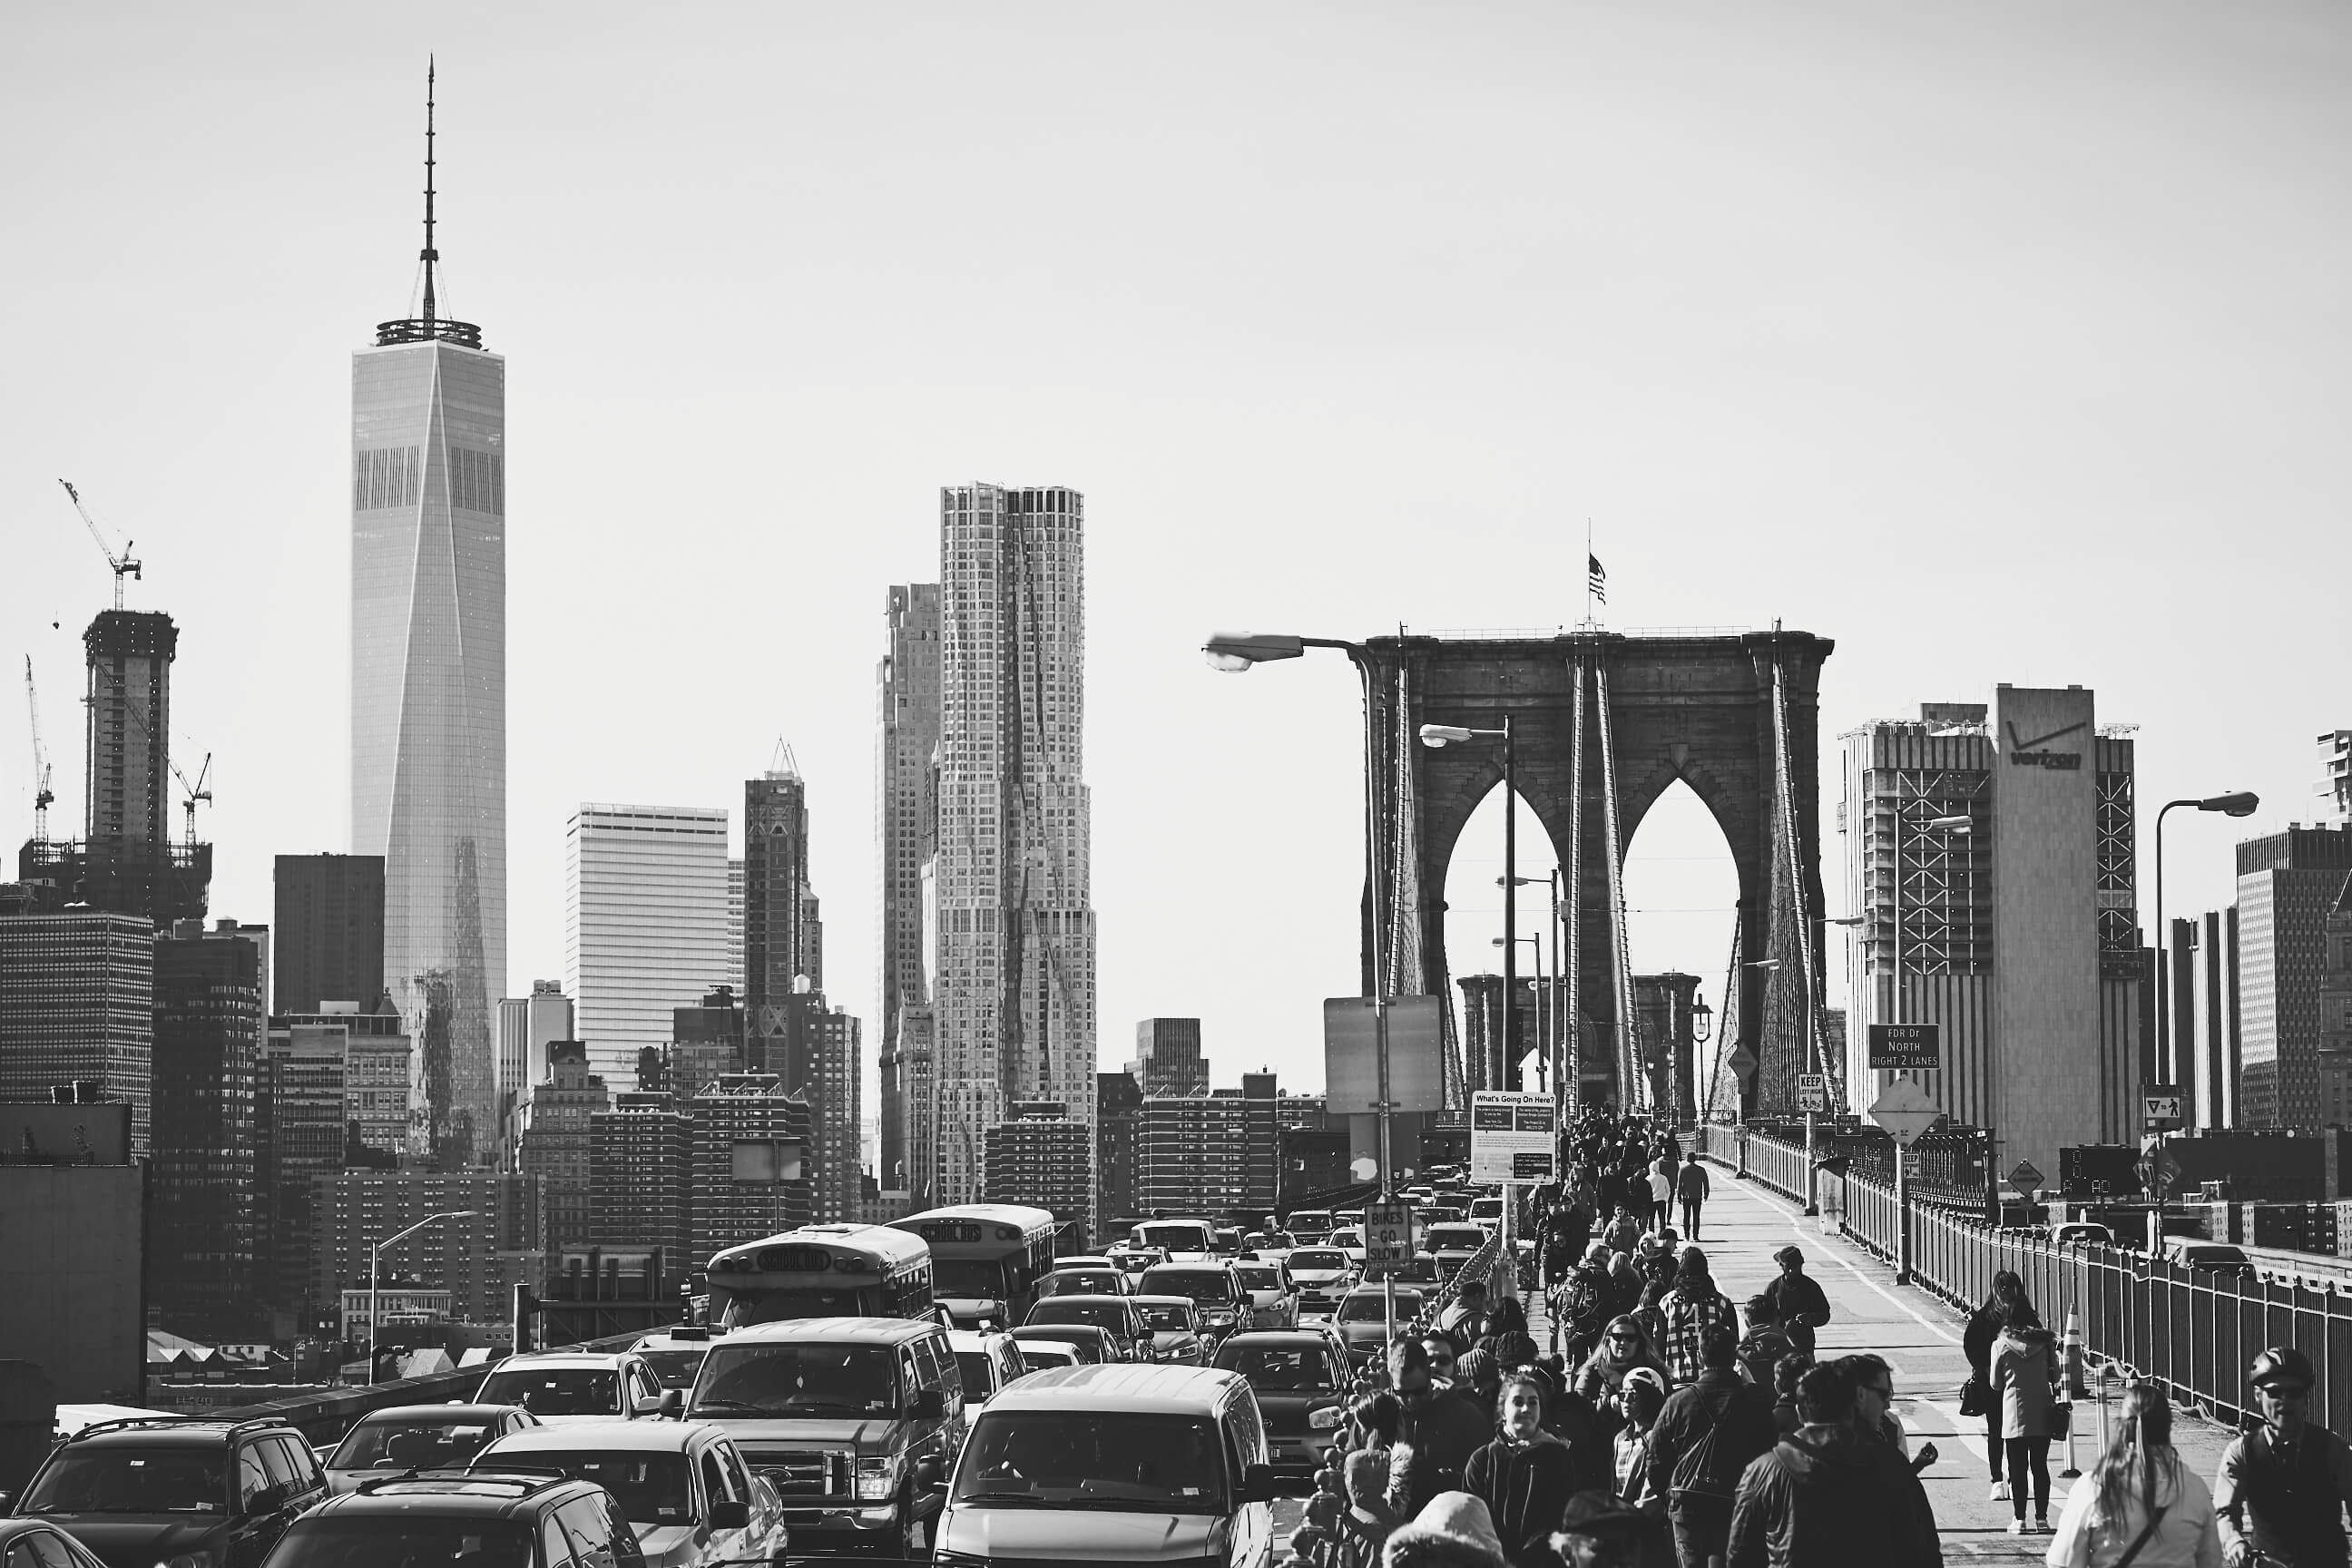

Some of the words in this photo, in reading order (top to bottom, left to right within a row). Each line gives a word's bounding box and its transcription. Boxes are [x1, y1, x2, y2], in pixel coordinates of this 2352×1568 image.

[2011, 749, 2081, 769] verizon
[1888, 1028, 1905, 1037] FDR
[1910, 1028, 1919, 1037] Dr
[1888, 1041, 1920, 1052] NORTH
[1872, 1056, 1898, 1065] RIGHT
[1901, 1054, 1906, 1065] 2
[1911, 1056, 1937, 1065] LANES
[1800, 1076, 1821, 1087] KEEP
[1476, 1094, 1499, 1102] What's
[1501, 1095, 1522, 1104] Going
[1524, 1095, 1534, 1103] On
[1371, 1211, 1404, 1225] BIKES
[922, 1225, 959, 1242] SCHOOL
[961, 1225, 981, 1242] BUS
[1380, 1229, 1396, 1243] GO
